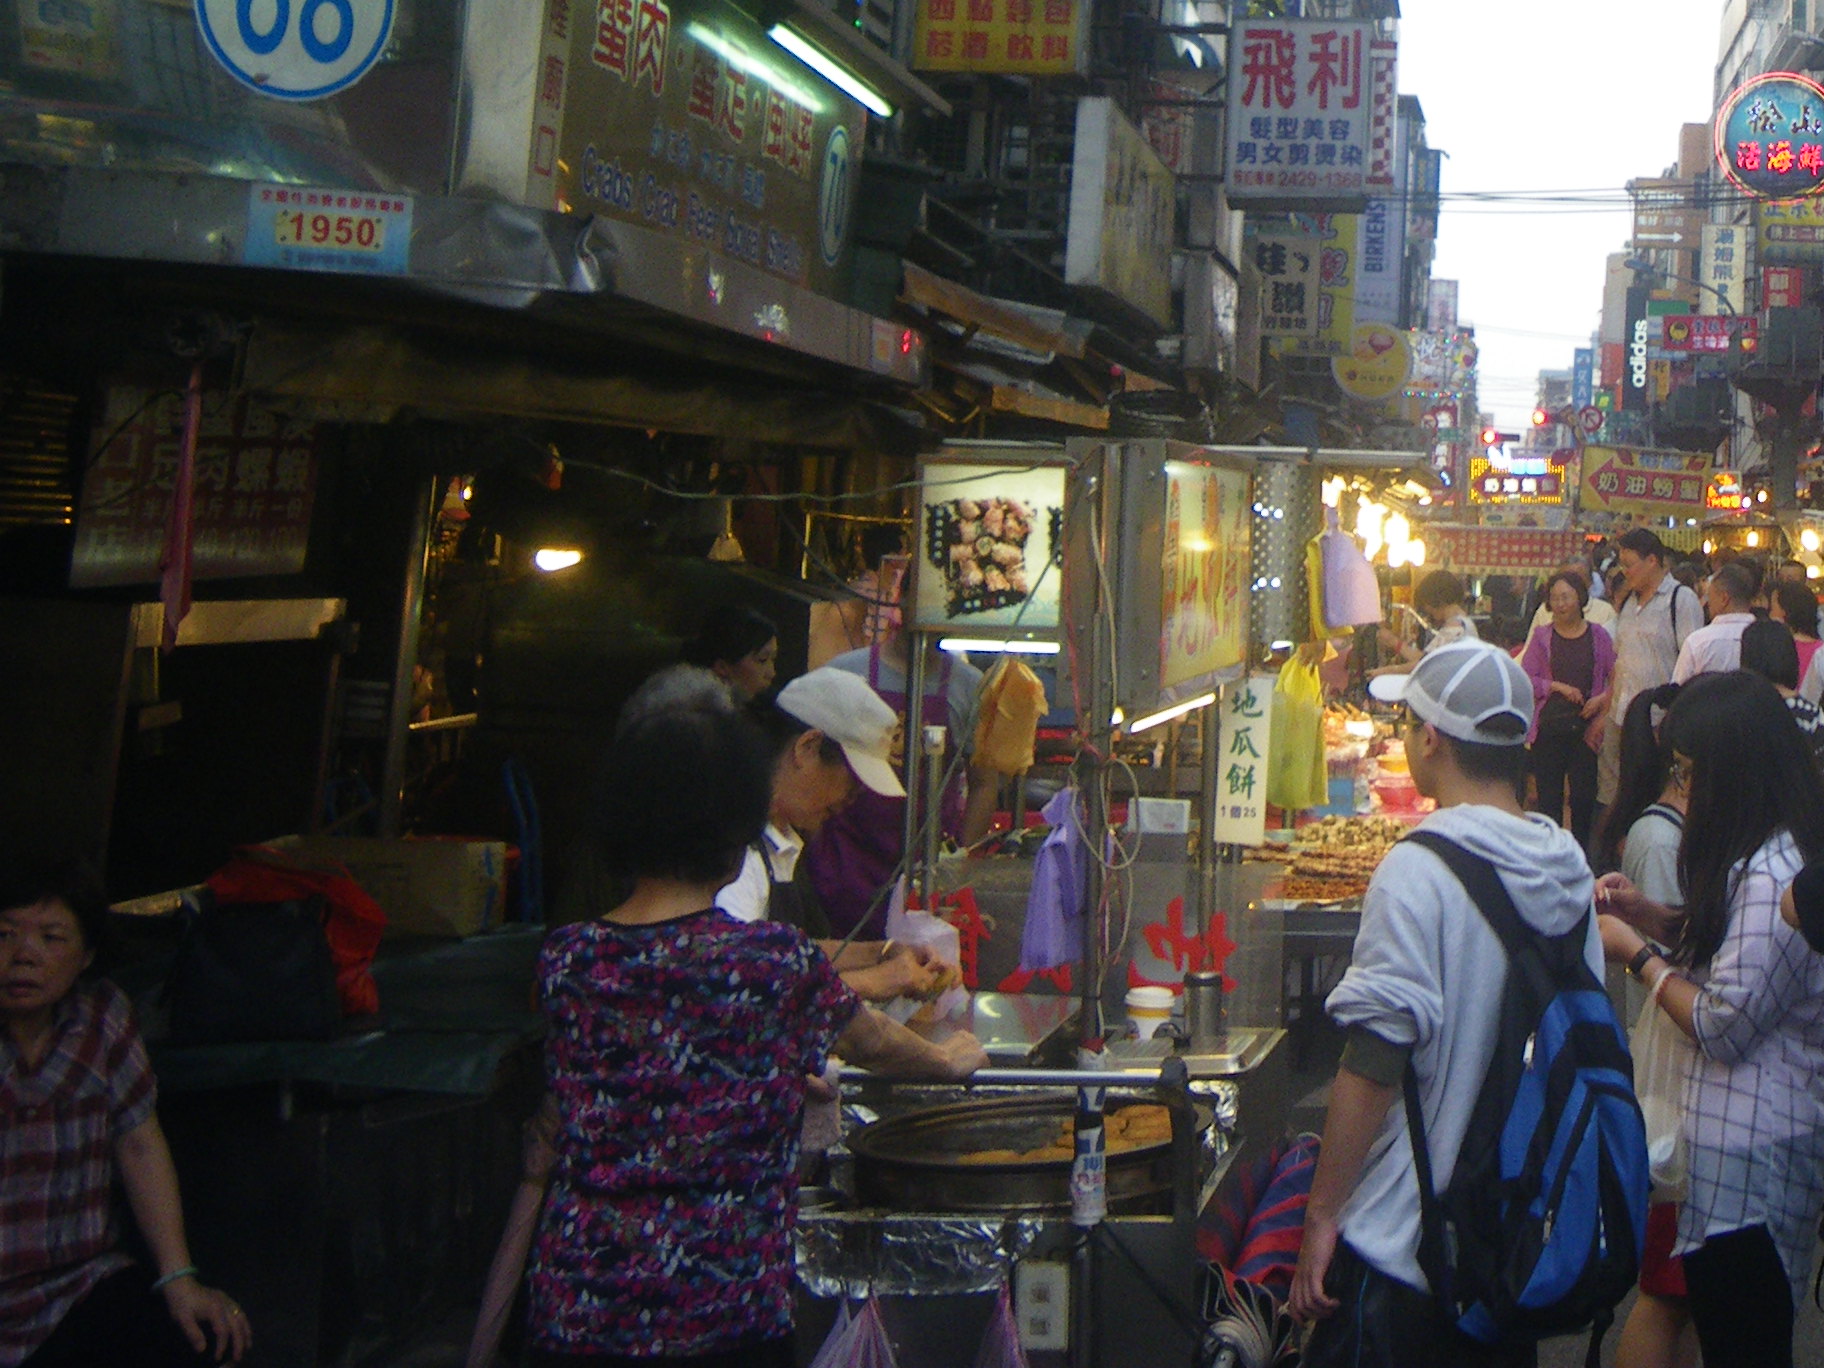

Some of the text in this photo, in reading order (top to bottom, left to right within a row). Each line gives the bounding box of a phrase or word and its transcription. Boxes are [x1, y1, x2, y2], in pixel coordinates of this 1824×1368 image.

[1241, 29, 1362, 110] 飛利
[1250, 116, 1351, 141] 髮型美容
[1748, 100, 1822, 135] 松山
[1236, 142, 1363, 166] 男女剪燙染
[1736, 140, 1824, 175] 活海鮮
[290, 213, 374, 247] 1950
[1630, 319, 1648, 389] adidas
[1597, 470, 1700, 503] 奶油螃蟹
[1226, 688, 1263, 801] 地瓜餅
